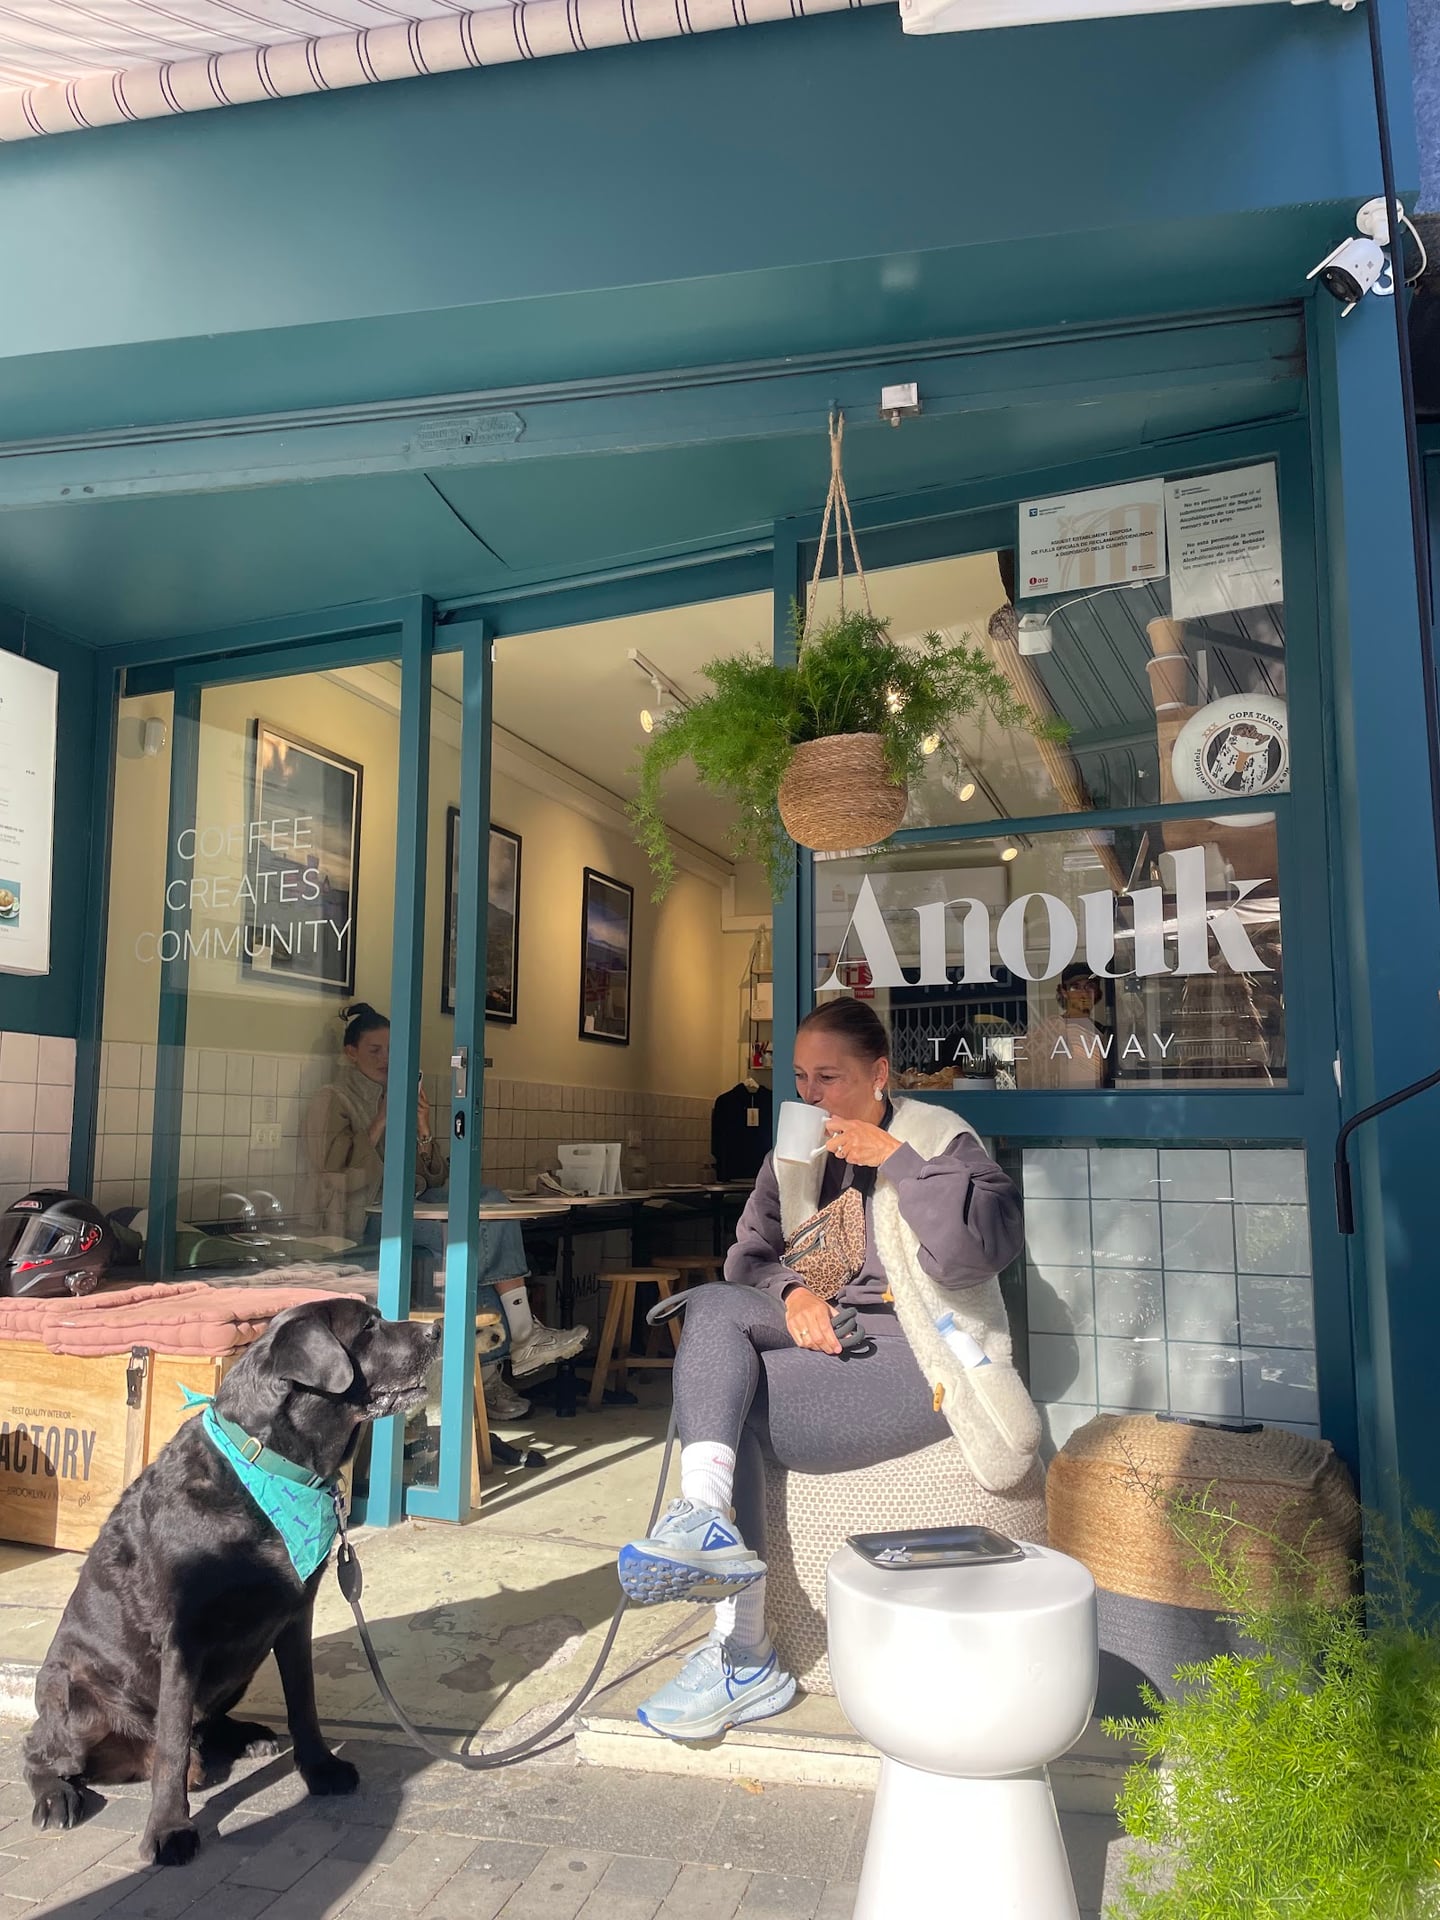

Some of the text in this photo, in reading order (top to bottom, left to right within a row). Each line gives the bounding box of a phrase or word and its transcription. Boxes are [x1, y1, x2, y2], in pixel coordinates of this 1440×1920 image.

[1229, 711, 1283, 731] COPA TANGA
[177, 816, 313, 860] COFFEE
[166, 868, 320, 911] CREATES
[814, 845, 1275, 991] Anouk
[135, 917, 352, 963] COMMUNITY
[927, 1032, 1175, 1062] TAKE AWAY
[12, 1406, 71, 1419] BEST QUALITY INTERIOR
